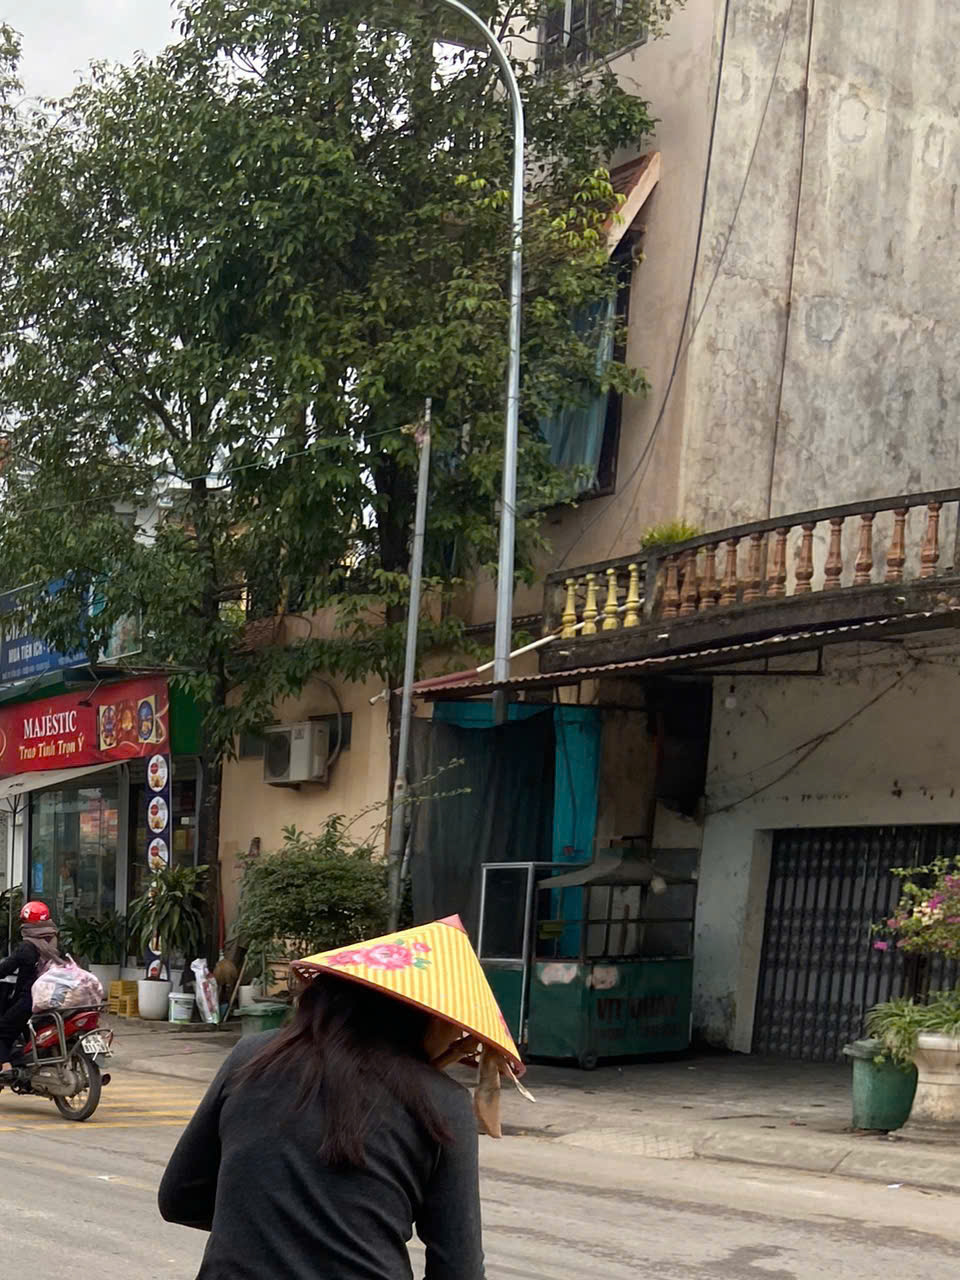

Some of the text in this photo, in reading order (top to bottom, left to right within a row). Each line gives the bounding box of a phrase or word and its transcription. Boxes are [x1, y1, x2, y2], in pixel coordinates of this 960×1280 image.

[23, 708, 77, 740] MAJÉSTIC
[18, 732, 85, 761] Trao Tình Trọn Ý
